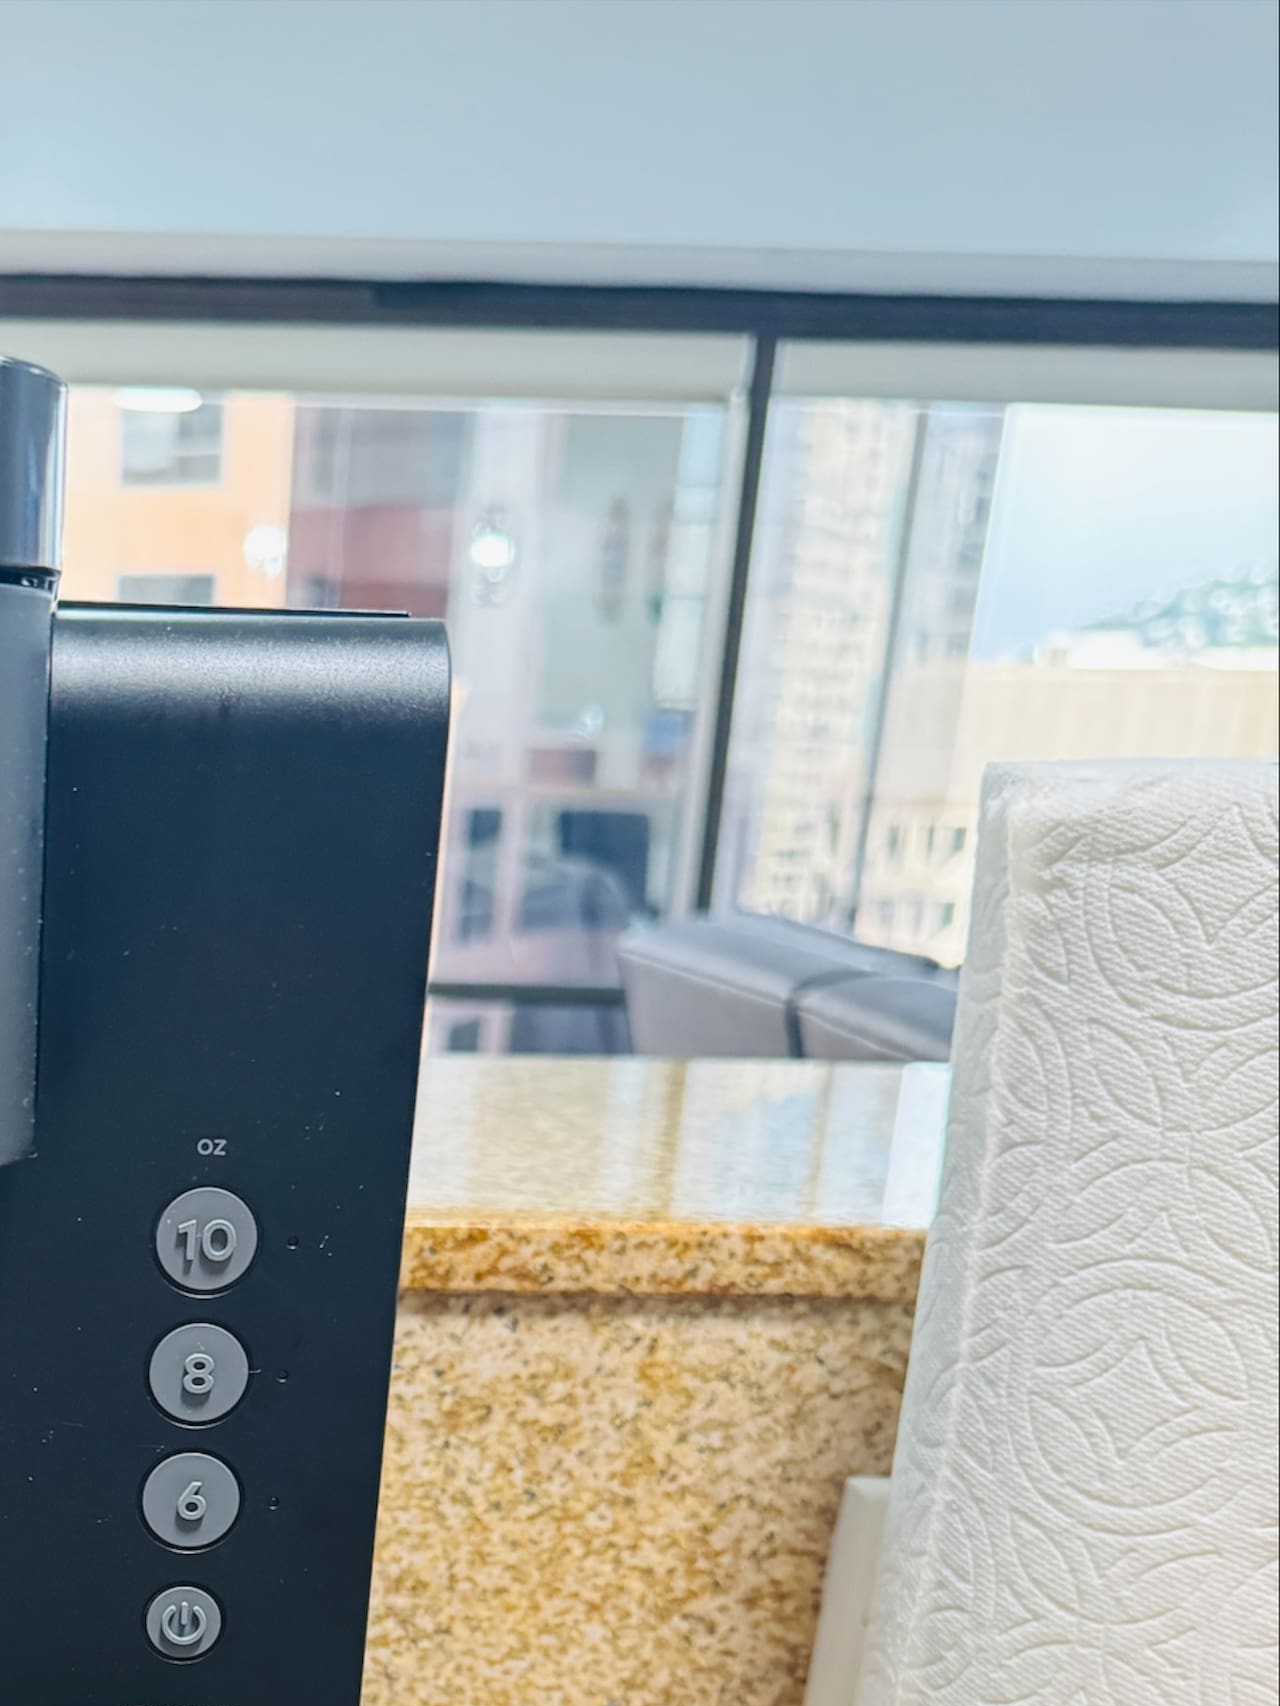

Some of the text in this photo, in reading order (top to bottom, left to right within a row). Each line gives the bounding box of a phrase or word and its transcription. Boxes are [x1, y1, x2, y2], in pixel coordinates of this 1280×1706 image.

[197, 1138, 228, 1156] OZ
[177, 1218, 238, 1262] 10
[182, 1353, 215, 1395] 8
[176, 1481, 207, 1521] 6
